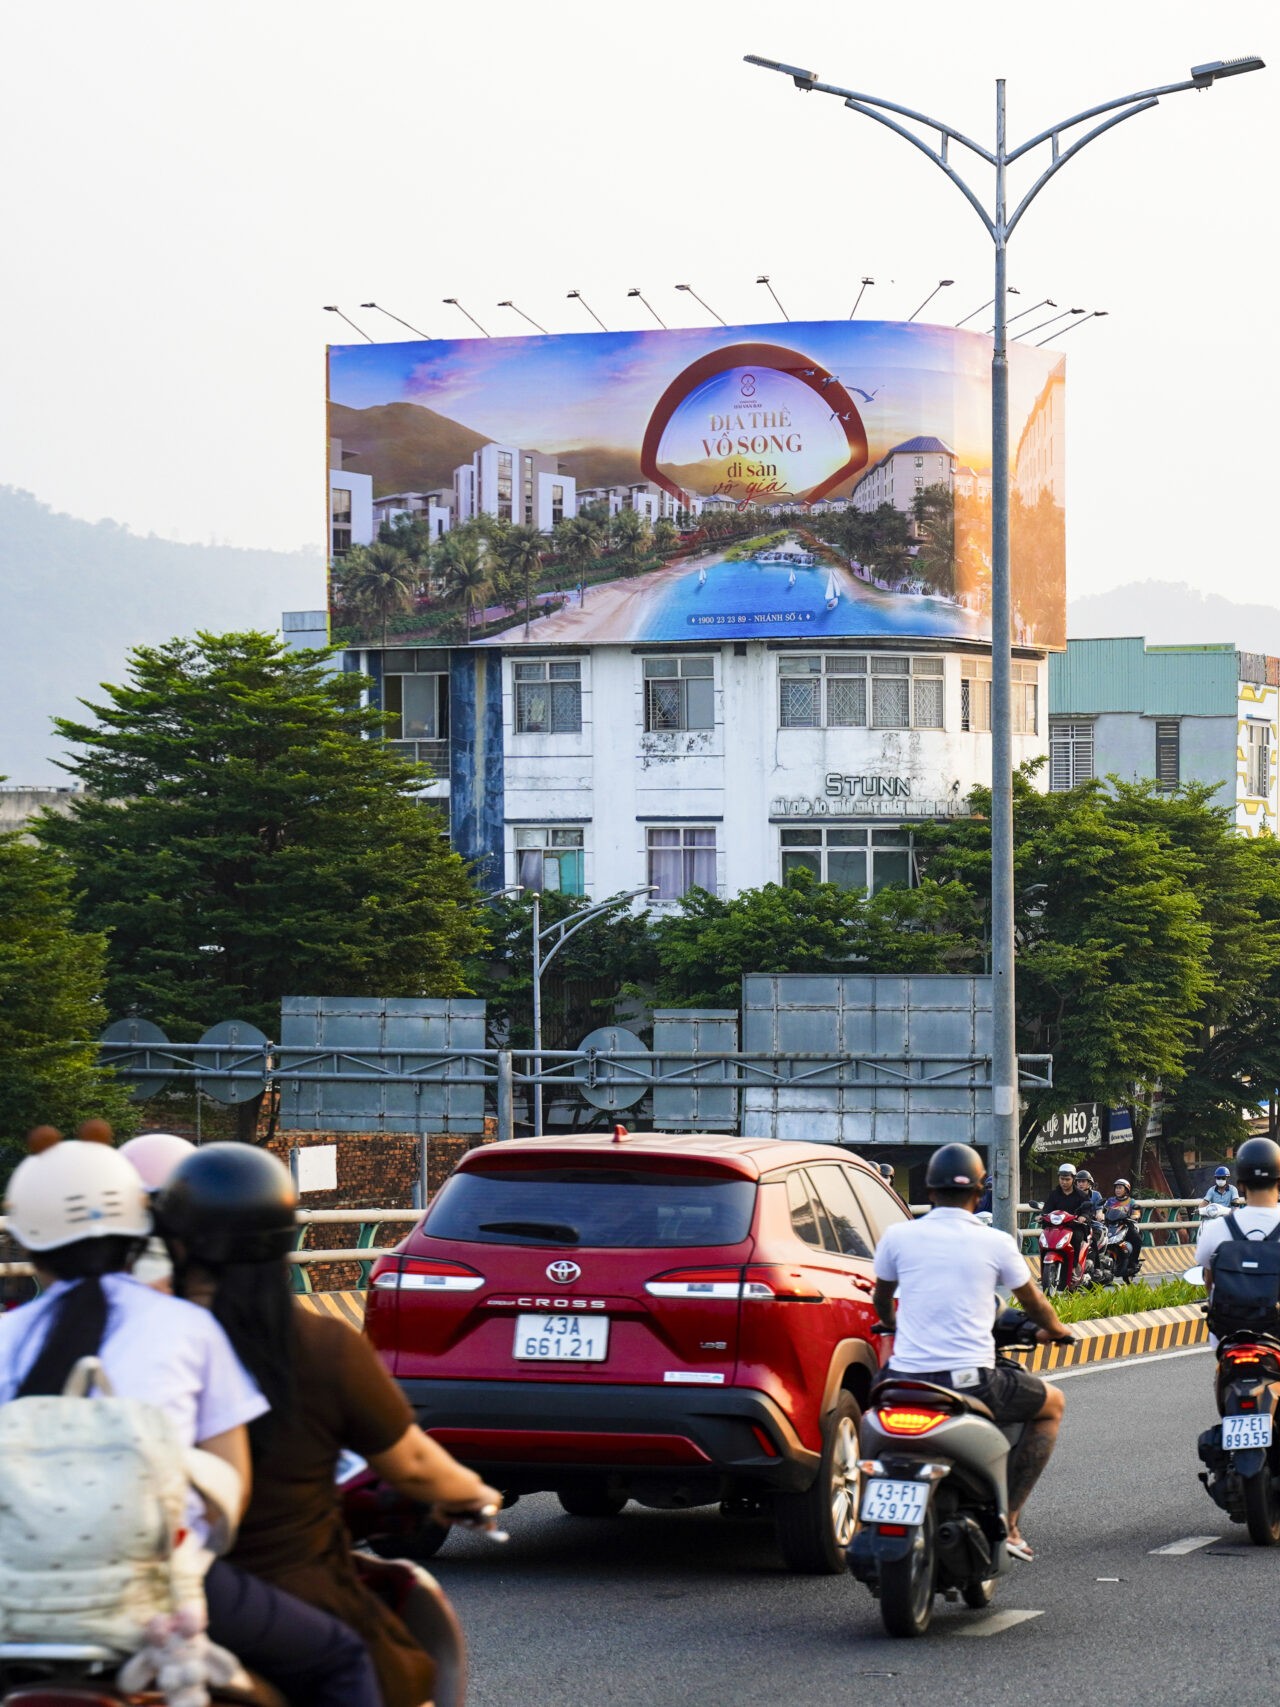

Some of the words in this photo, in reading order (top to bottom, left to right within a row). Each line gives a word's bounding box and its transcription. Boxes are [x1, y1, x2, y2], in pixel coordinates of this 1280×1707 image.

[737, 433, 802, 455] SONG
[727, 462, 742, 478] di
[746, 461, 777, 477] sản
[712, 480, 739, 496] vô
[737, 478, 794, 511] giá
[717, 616, 725, 624] 23
[737, 615, 747, 623] 89
[754, 613, 783, 622] NHÁNH
[785, 611, 796, 621] SỐ
[1063, 1107, 1087, 1135] MÈO
[518, 1298, 606, 1308] CROSS
[543, 1316, 580, 1335] 43A
[525, 1337, 593, 1356] 661.21
[1231, 1418, 1262, 1432] 77-E1
[1225, 1432, 1269, 1448] 893.55
[876, 1484, 917, 1502] 43-F1
[866, 1501, 922, 1521] 429.77
